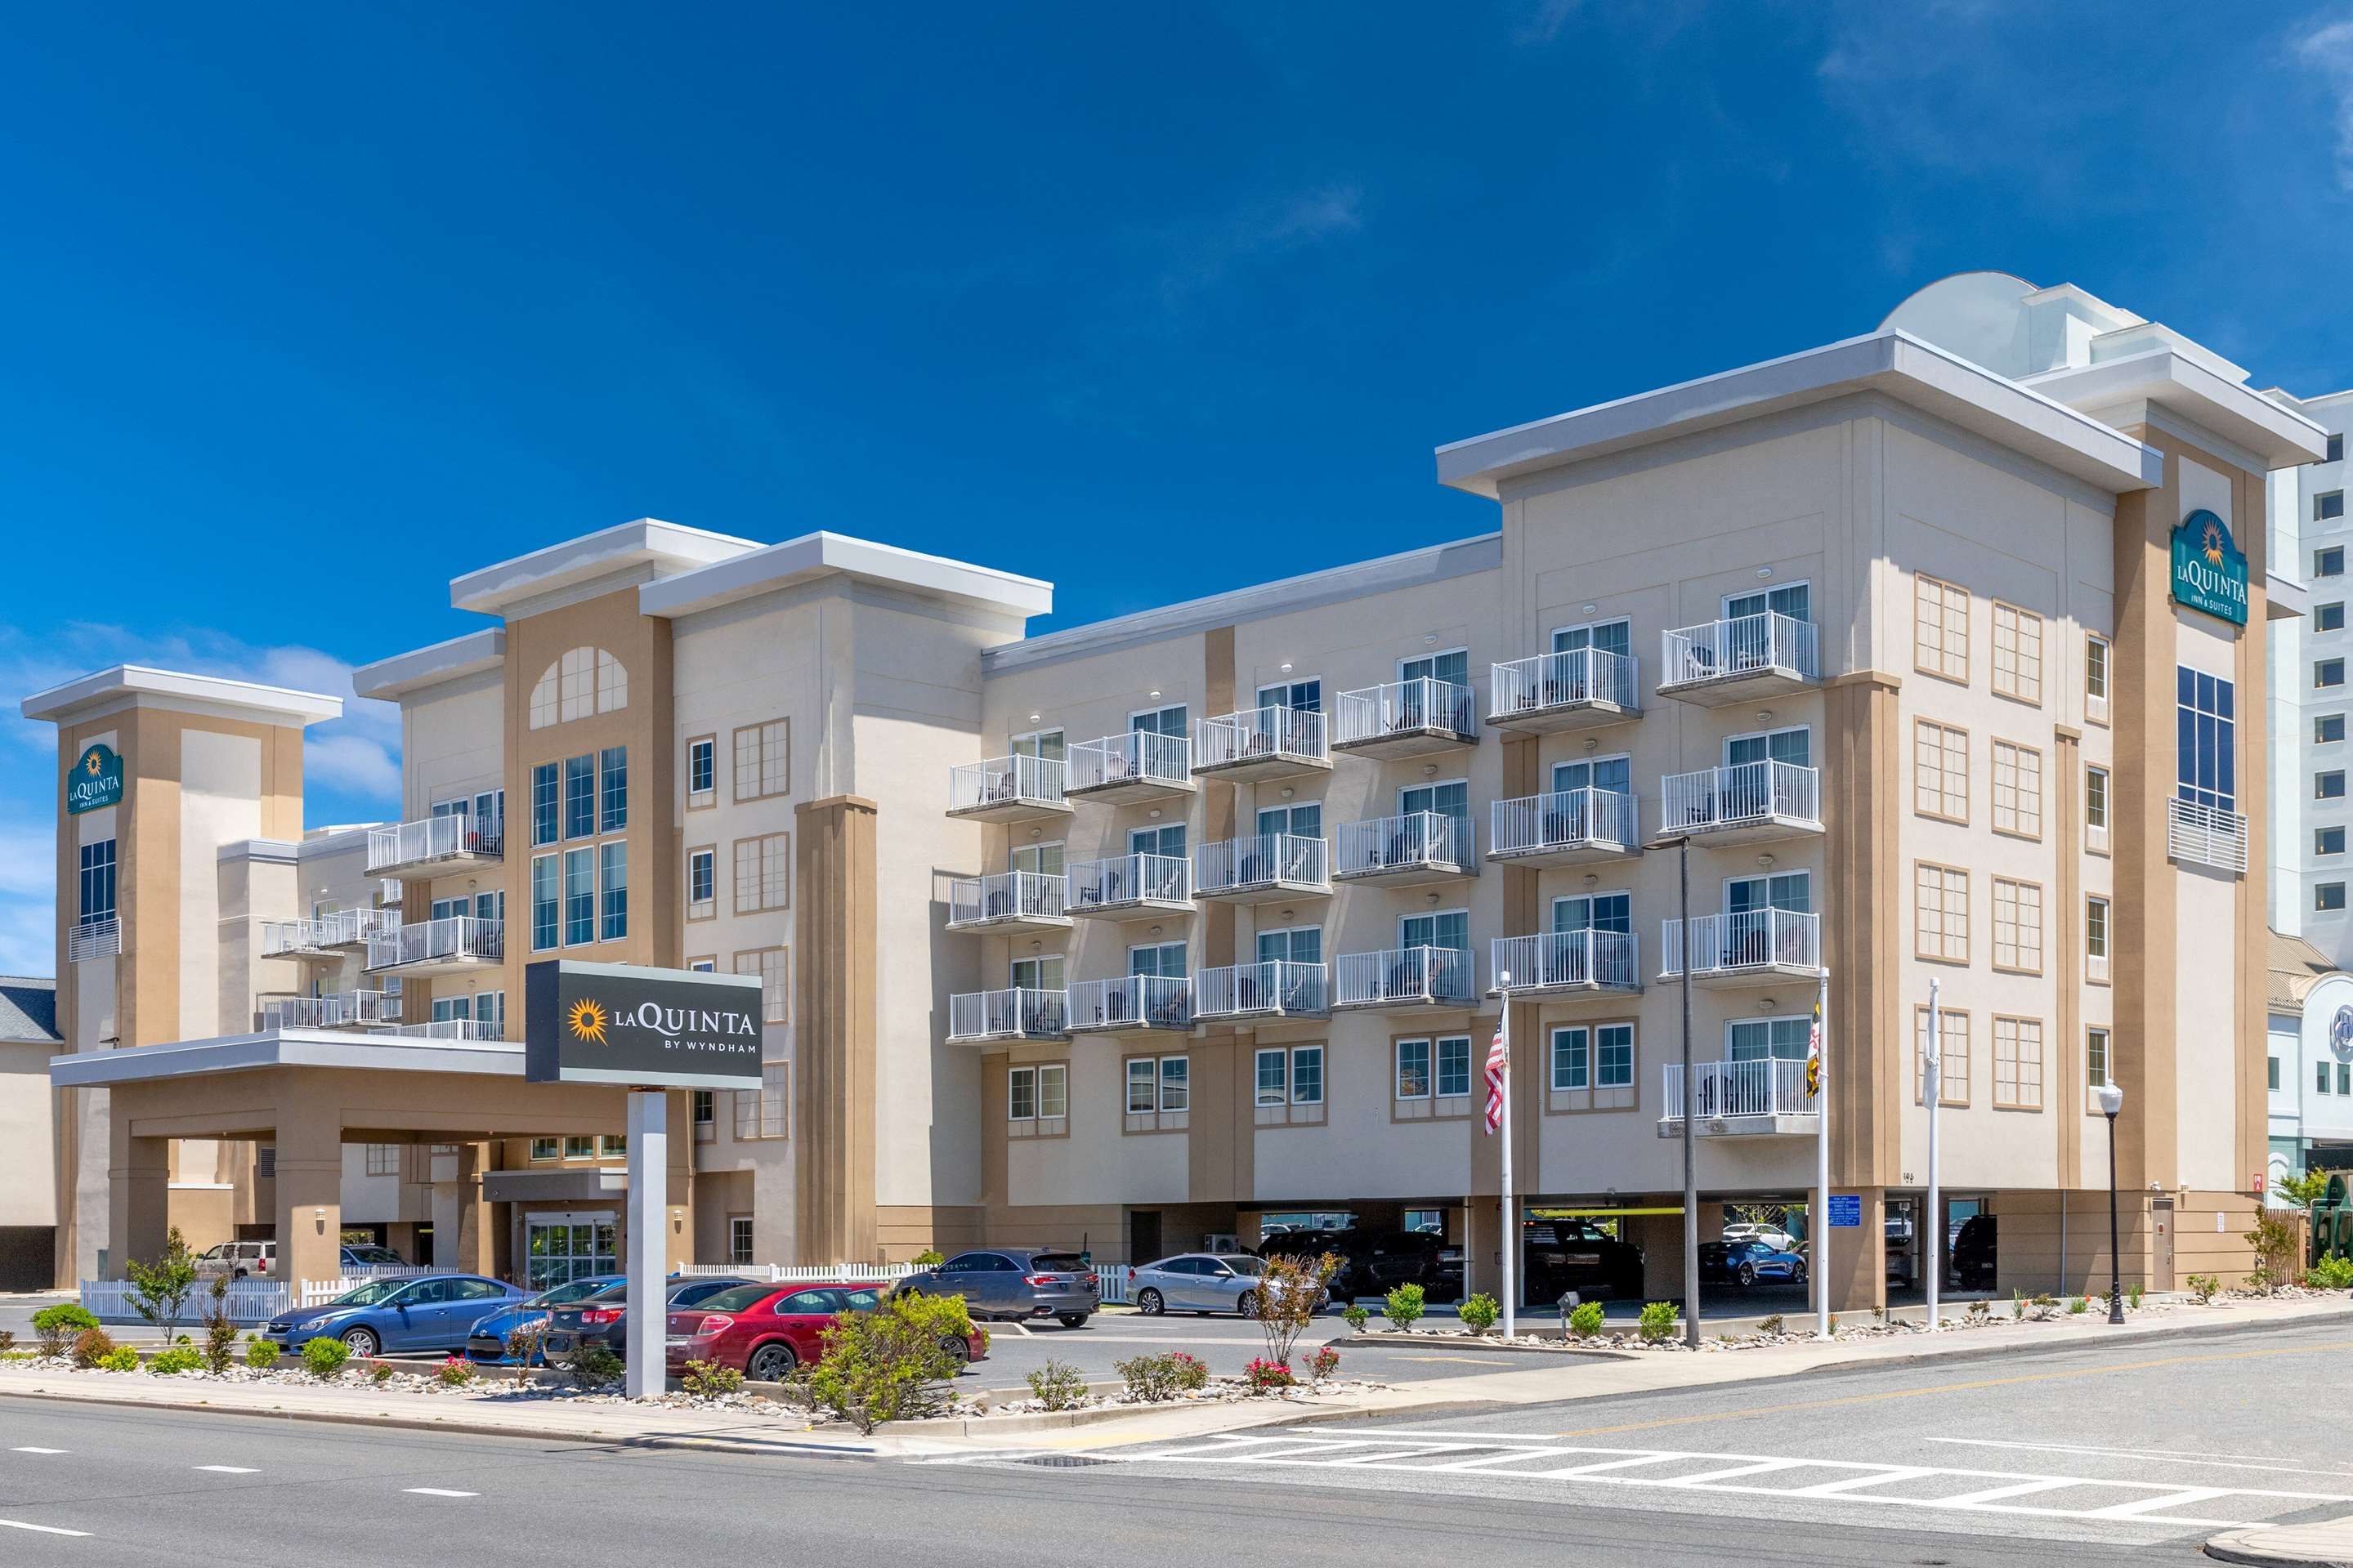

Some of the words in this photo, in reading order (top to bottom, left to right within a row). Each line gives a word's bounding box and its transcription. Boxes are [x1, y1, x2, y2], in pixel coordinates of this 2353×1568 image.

[2191, 593, 2203, 606] INN
[2209, 599, 2232, 616] SUITES
[92, 795, 109, 805] SUITES
[664, 1040, 680, 1049] BY
[687, 1041, 757, 1053] WYNDHAM
